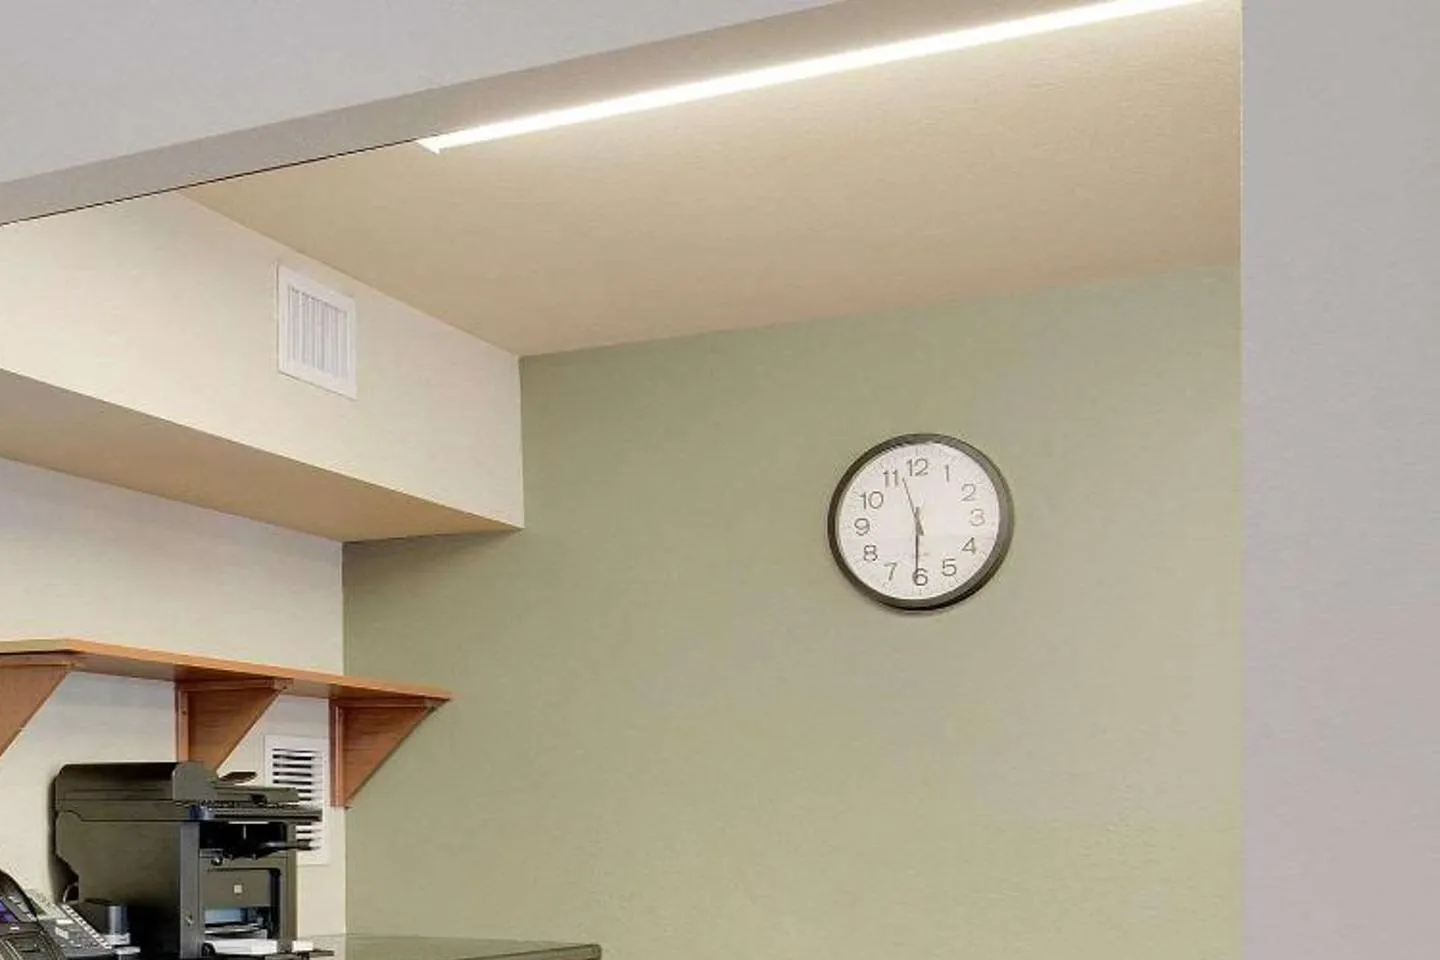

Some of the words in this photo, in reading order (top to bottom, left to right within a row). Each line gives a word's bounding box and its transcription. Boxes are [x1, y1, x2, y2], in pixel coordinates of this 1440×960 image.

[907, 458, 929, 476] 12
[944, 465, 950, 482] 1
[883, 469, 899, 487] 11
[859, 491, 884, 509] 10
[962, 483, 976, 501] 2
[970, 509, 985, 526] 3
[854, 518, 870, 536] 9
[863, 545, 878, 562] 8
[962, 537, 976, 554] 4
[885, 563, 898, 581] 7
[913, 568, 928, 586] 6
[942, 559, 957, 577] 5
